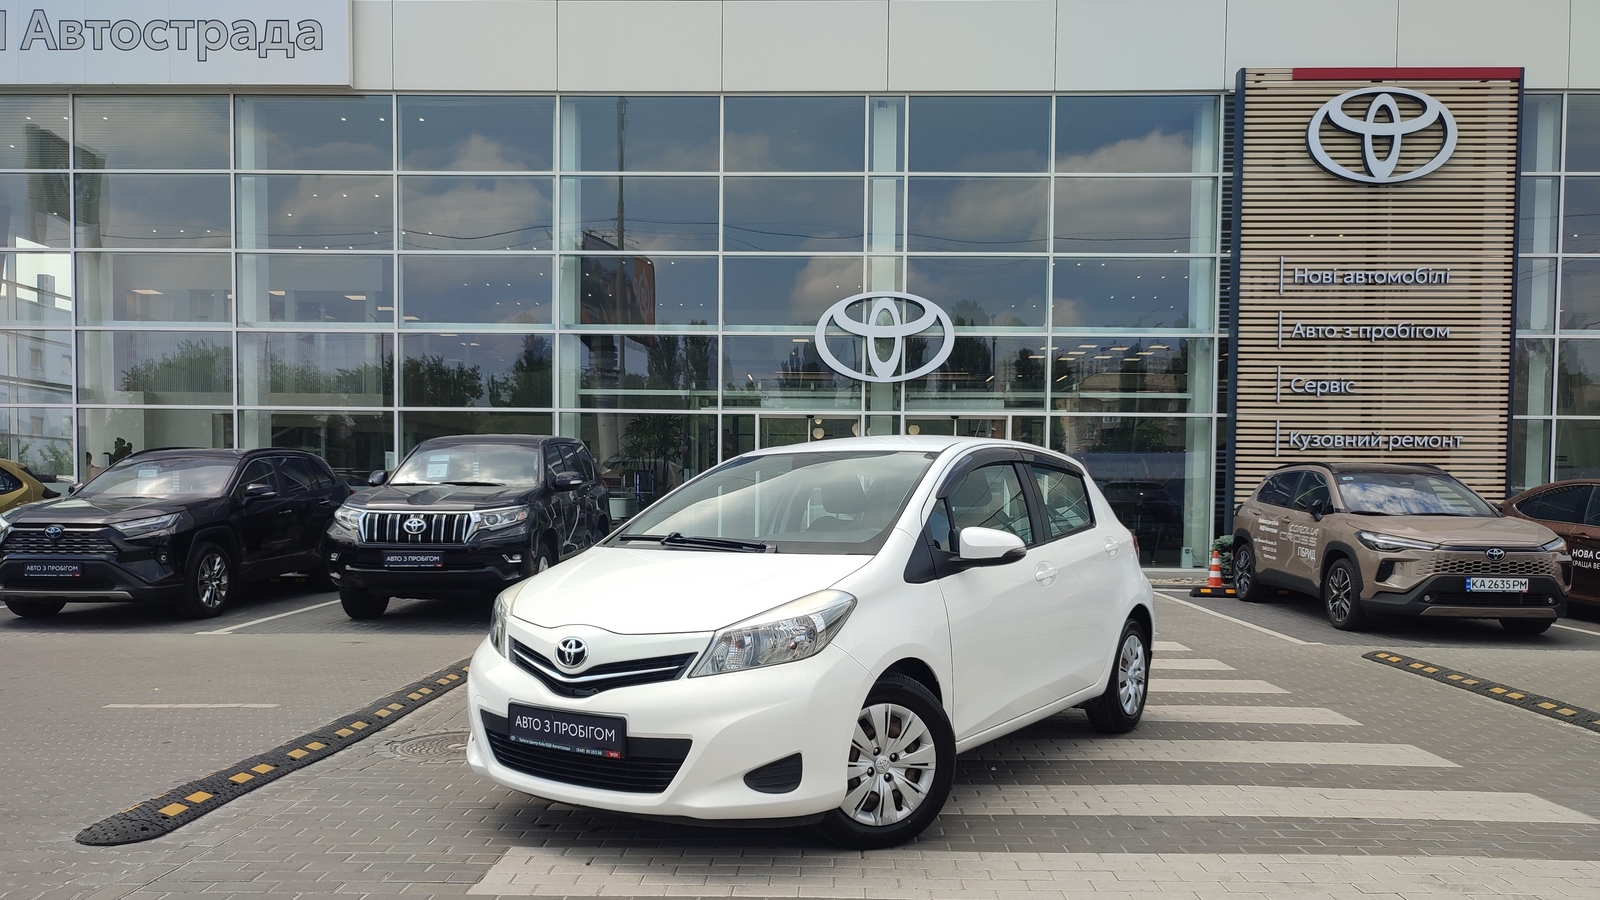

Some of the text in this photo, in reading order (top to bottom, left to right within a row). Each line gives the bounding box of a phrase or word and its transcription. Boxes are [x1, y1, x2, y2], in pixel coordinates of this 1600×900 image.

[20, 9, 323, 61] Автострада
[1293, 267, 1451, 284] Нові автомобілі
[1291, 322, 1450, 343] Авто з пробігом
[1290, 377, 1356, 397] Сервіс
[1289, 430, 1463, 451] Кузовний ремонт
[1279, 531, 1317, 547] CROSS
[1572, 548, 1594, 559] НОВА
[1471, 579, 1528, 590] KA 2635 PM
[515, 715, 615, 742] АВТО З ПРОБІГОМ
